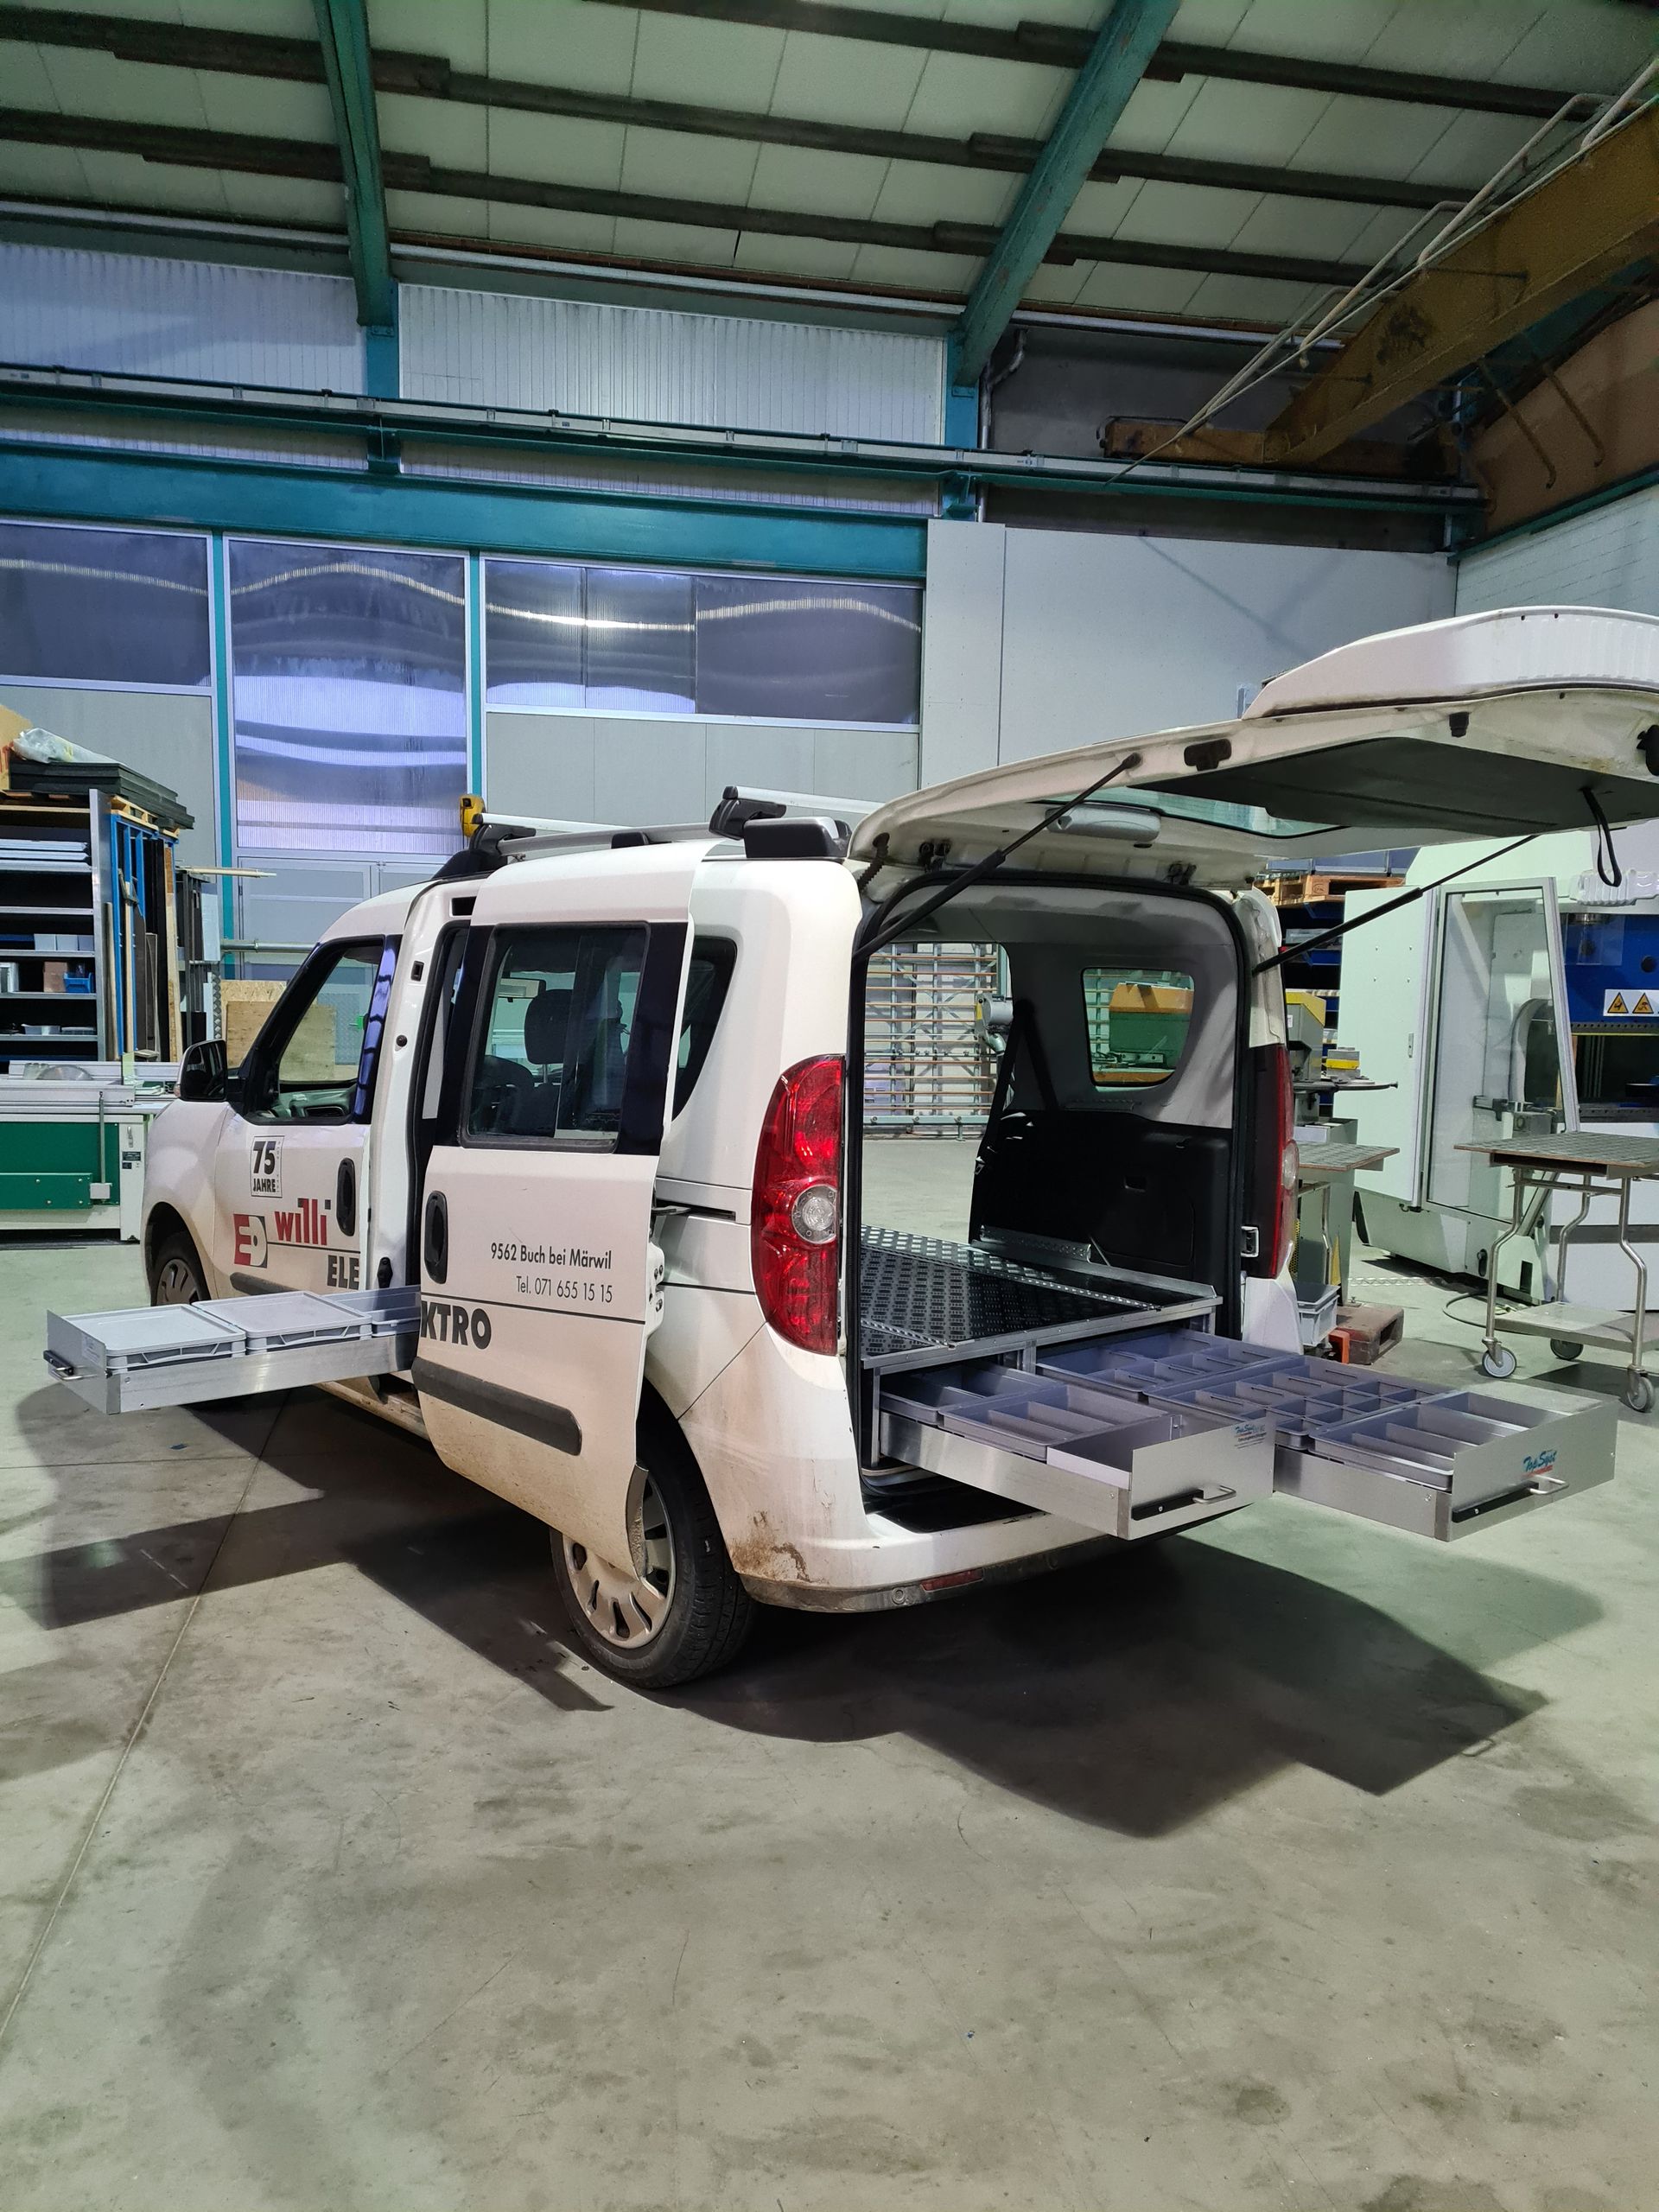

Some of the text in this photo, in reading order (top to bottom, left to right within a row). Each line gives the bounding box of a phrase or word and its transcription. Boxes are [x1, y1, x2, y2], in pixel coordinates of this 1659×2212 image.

[253, 1141, 276, 1175] 75
[253, 1178, 276, 1192] JAHRE
[274, 1198, 331, 1246] willi
[327, 1255, 359, 1290] ELE
[491, 1242, 612, 1269] 9562 Buch bei Märwil
[516, 1275, 613, 1303] Tel. 071 655 15 15
[420, 1300, 492, 1350] KTRO
